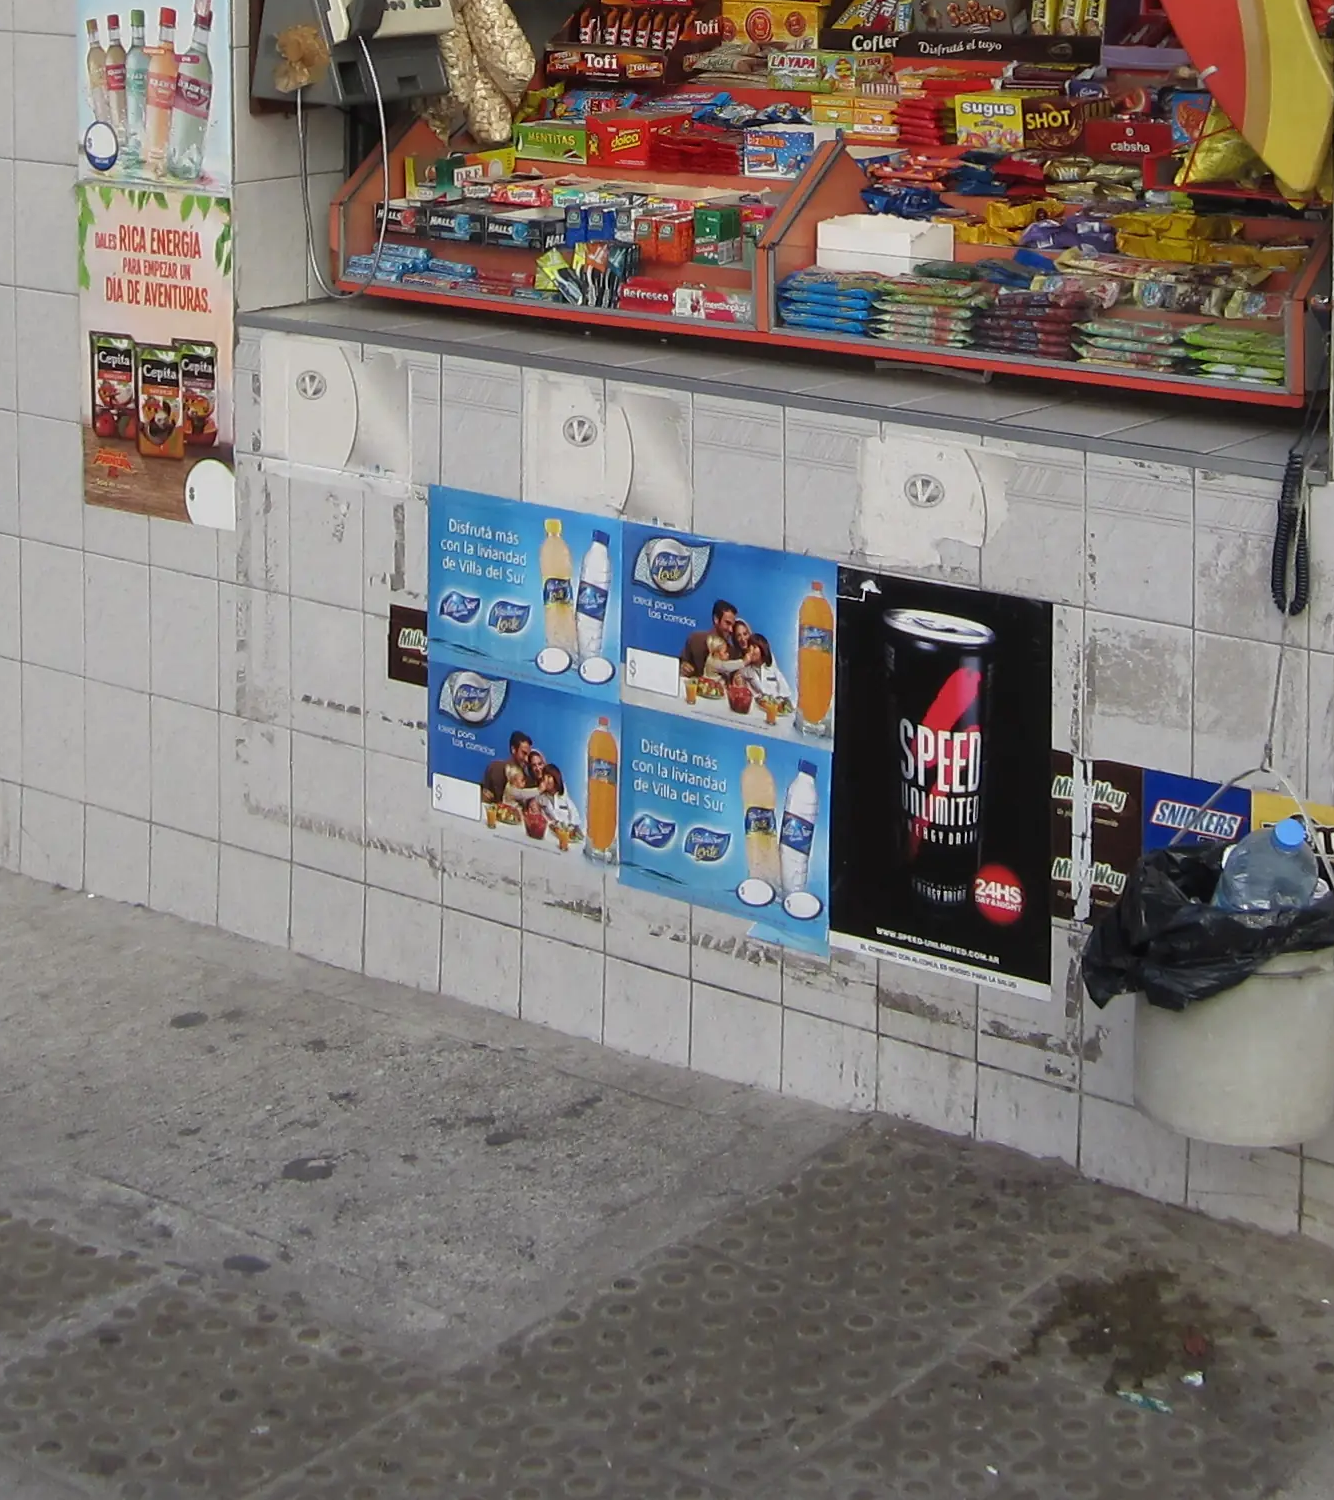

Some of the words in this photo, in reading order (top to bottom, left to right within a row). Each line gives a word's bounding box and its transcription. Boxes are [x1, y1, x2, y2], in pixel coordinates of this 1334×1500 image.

[694, 20, 720, 36] Tofi
[851, 34, 899, 52] Cofler
[918, 39, 965, 57] Disfrutá
[966, 39, 976, 50] el
[978, 39, 1002, 53] tuyo
[584, 53, 618, 70] Tofi
[771, 55, 785, 68] LA
[787, 56, 816, 69] YAPA
[961, 102, 1016, 118] sugus
[1025, 110, 1071, 131] SHOT
[527, 131, 576, 146] MENTITAS
[1110, 140, 1151, 154] cabsha
[430, 216, 455, 228] HALLS
[488, 223, 513, 235] HALLS
[95, 232, 117, 250] DALES
[119, 224, 147, 253] RICA
[150, 224, 202, 259] ENERGÍA
[546, 233, 566, 248] HAL
[123, 257, 142, 275] PARA
[144, 260, 178, 280] EMPEZAR
[180, 264, 191, 281] UN
[106, 272, 124, 303] DÍA
[127, 279, 140, 306] DE
[144, 280, 212, 314] AVENTURAS.
[623, 288, 669, 302] Refresco
[99, 351, 130, 368] Cepita
[181, 359, 213, 376] Cepita
[143, 364, 178, 382] Cepita
[448, 518, 492, 541] Disfrutá
[495, 530, 519, 546] más
[440, 539, 461, 552] con
[463, 541, 474, 556] la
[477, 543, 528, 568] liviandad
[442, 555, 456, 570] de
[458, 559, 483, 576] Villa
[485, 563, 503, 581] del
[506, 569, 526, 586] Sur
[654, 600, 675, 613] para
[628, 658, 637, 677] $
[640, 738, 689, 765] Disfrutá
[692, 752, 718, 771] más
[899, 717, 982, 794] SPEED
[632, 758, 655, 774] con
[657, 762, 669, 779] la
[671, 765, 727, 794] liviandad
[434, 784, 443, 801] $
[633, 777, 649, 794] de
[652, 781, 678, 801] Villa
[681, 787, 701, 807] del
[703, 795, 727, 814] Sur
[1092, 780, 1127, 813] Way
[900, 780, 981, 827] UNLIMITED
[1154, 801, 1242, 839] SNICKERS
[1092, 862, 1127, 895] Way
[974, 878, 1023, 904] 24HS
